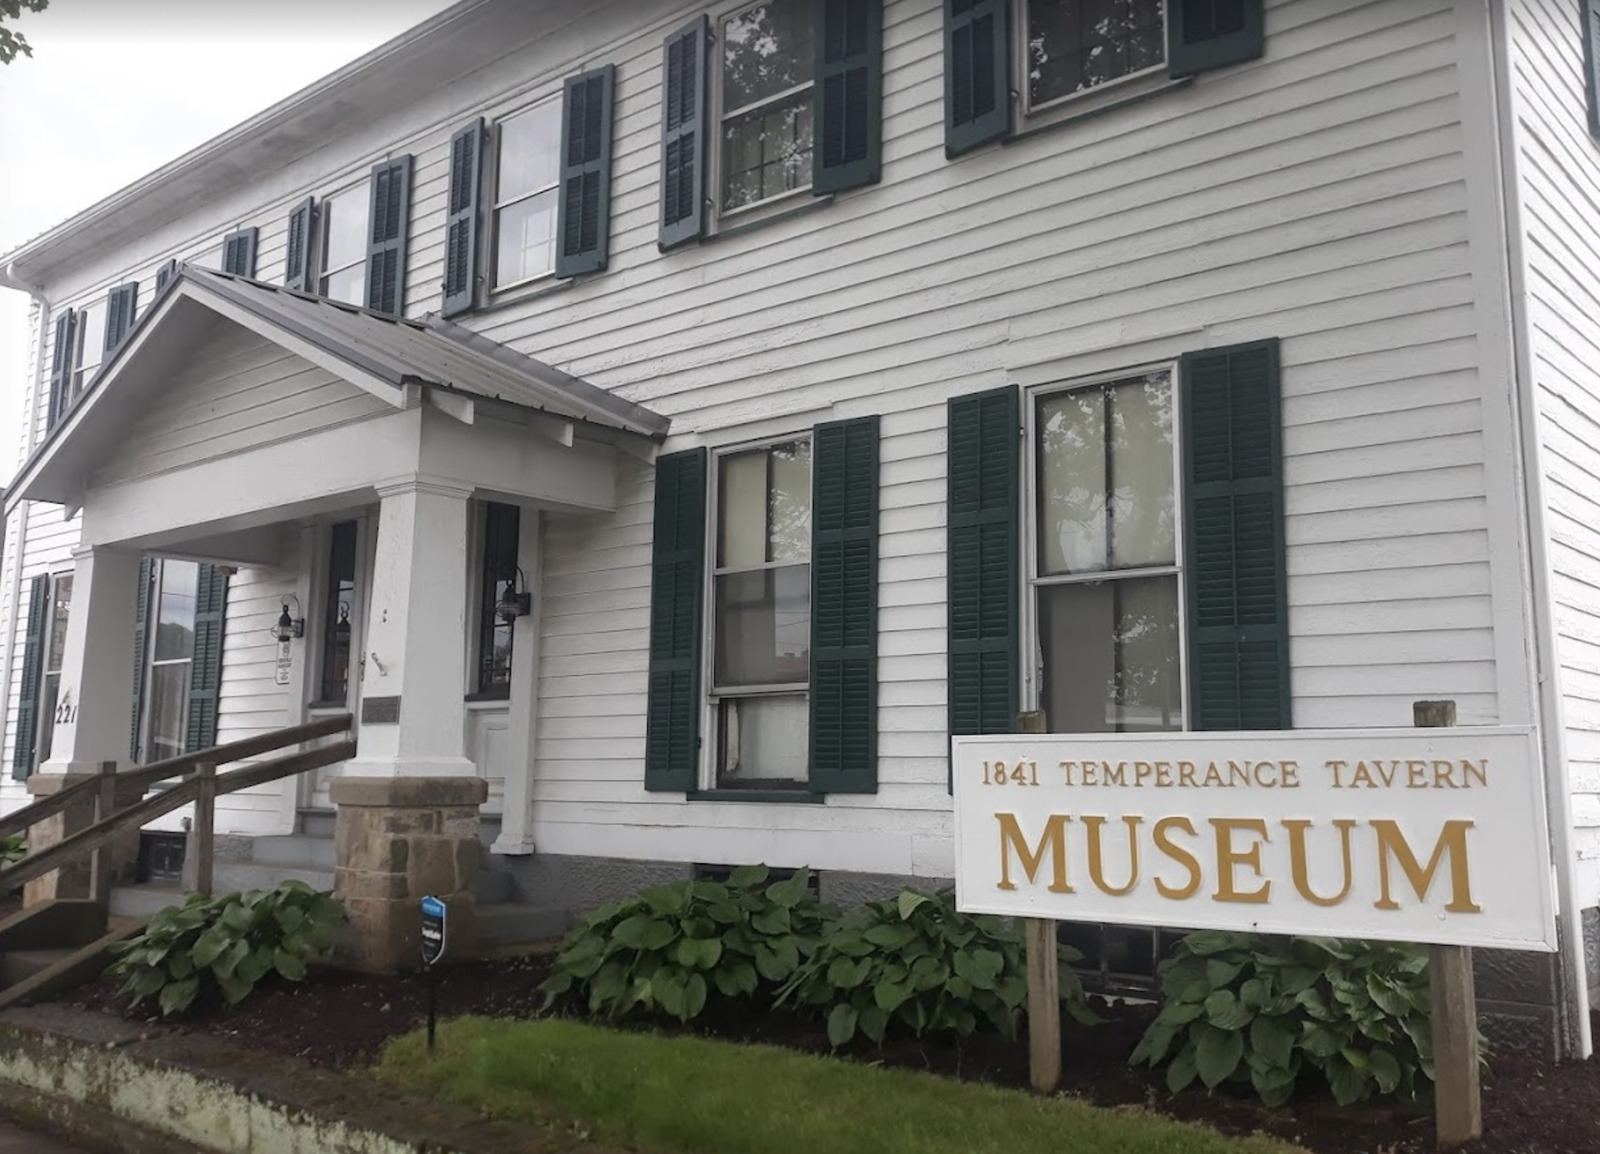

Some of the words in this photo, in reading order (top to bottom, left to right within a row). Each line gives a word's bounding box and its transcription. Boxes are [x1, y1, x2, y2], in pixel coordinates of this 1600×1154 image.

[56, 704, 77, 724] 221
[982, 761, 1040, 786] 1841
[1060, 760, 1300, 788] TEMPERANCE
[1325, 759, 1489, 788] TAVERN
[995, 812, 1483, 913] MUSEUM
